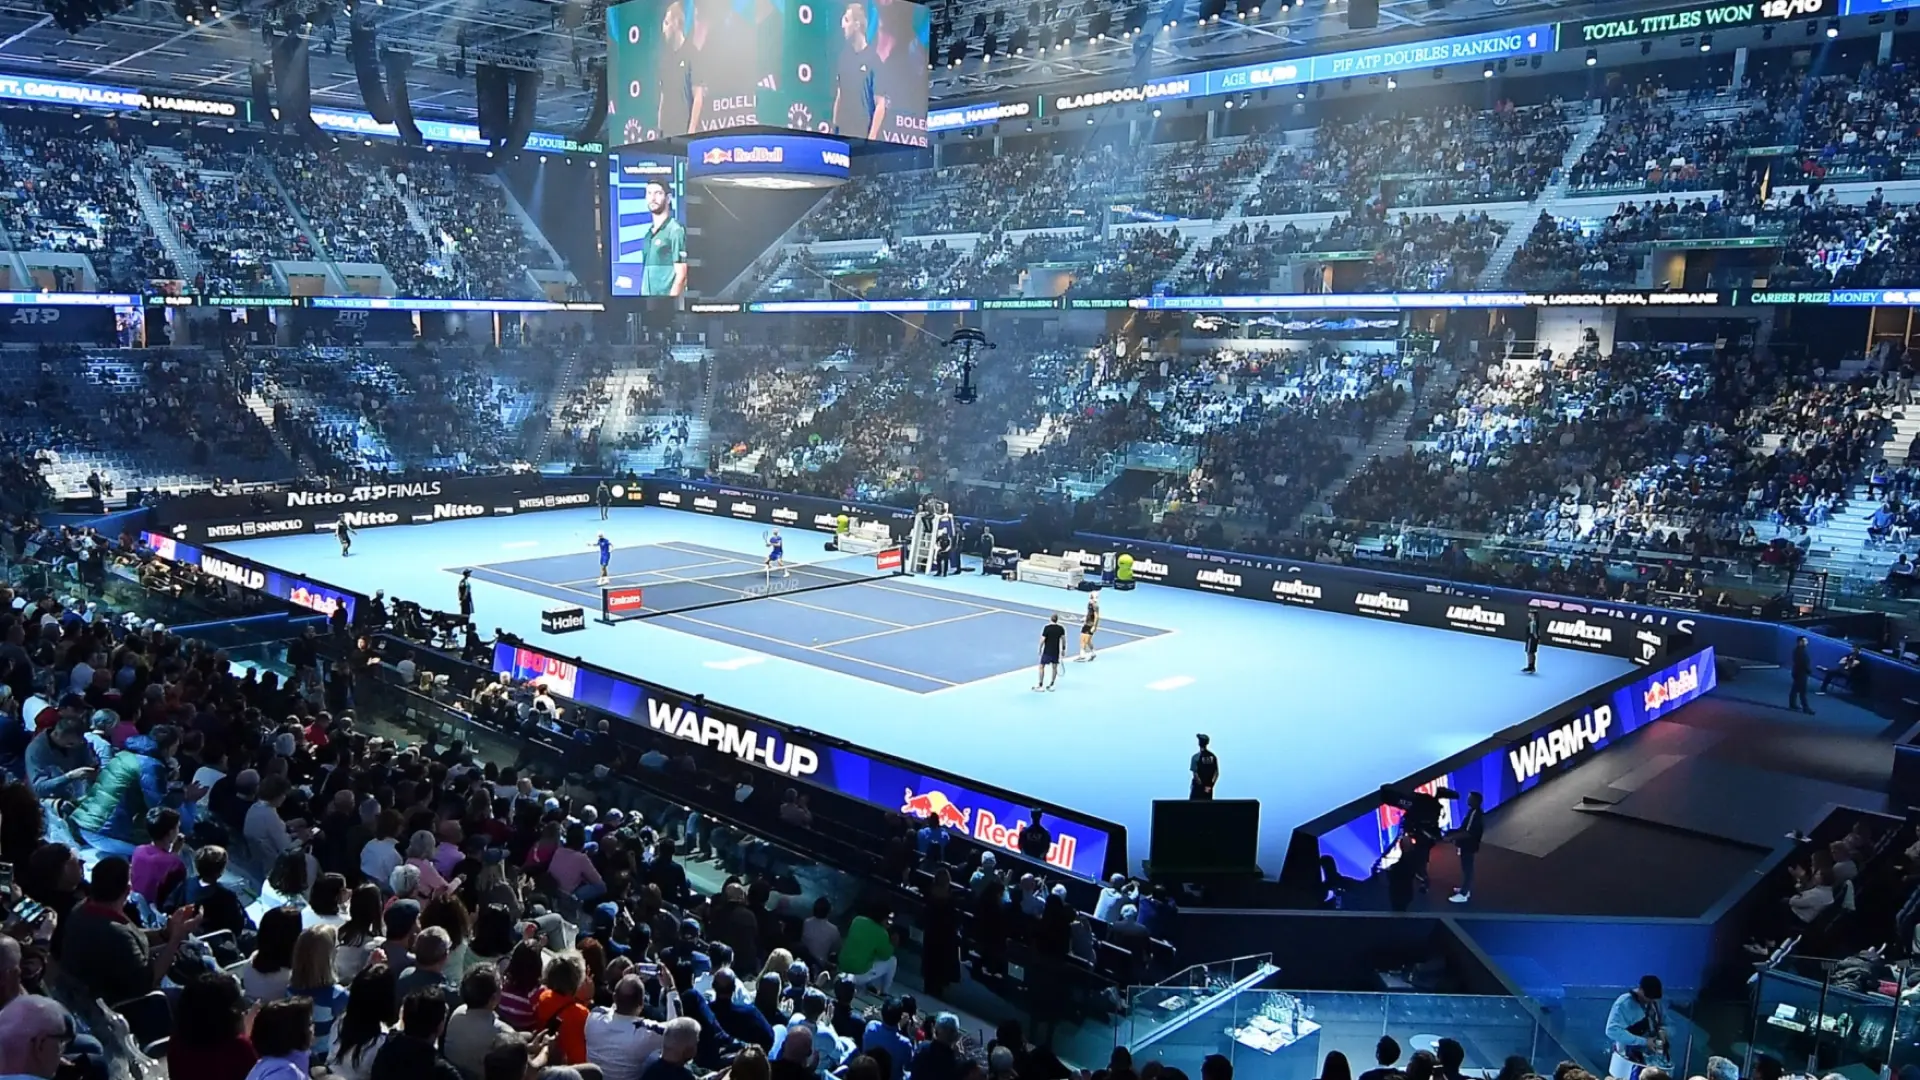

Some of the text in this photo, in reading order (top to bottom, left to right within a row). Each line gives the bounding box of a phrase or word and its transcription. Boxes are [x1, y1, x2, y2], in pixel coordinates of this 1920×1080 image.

[1583, 24, 1638, 41] TOTAL
[1641, 11, 1702, 33] TITLES
[1705, 4, 1753, 25] WON
[1333, 32, 1538, 73] PIF ATP DOUBLES RANKING 1
[1221, 73, 1246, 88] AGE
[153, 99, 236, 116] HAMMOND
[966, 103, 1030, 121] HAMMOND
[539, 138, 577, 150] DOUBLES
[1549, 295, 1603, 306] LONDON,
[1605, 293, 1646, 304] DOHA,
[1751, 292, 1796, 304] CAREER
[1797, 292, 1831, 304] PRIZE
[1832, 292, 1878, 304] MONEY
[10, 308, 60, 324] ATP
[287, 481, 441, 507] Nitto ATP FINALS
[344, 511, 398, 527] Nitto
[433, 503, 484, 519] Nitto
[610, 594, 641, 605] Emirates
[553, 612, 585, 631] Haier
[1446, 604, 1506, 626] LAVAZZA
[1547, 619, 1612, 643] LAVAZZA
[647, 698, 819, 777] WARM-UP
[1509, 705, 1612, 783] WARM-UP
[973, 808, 1027, 854] Red
